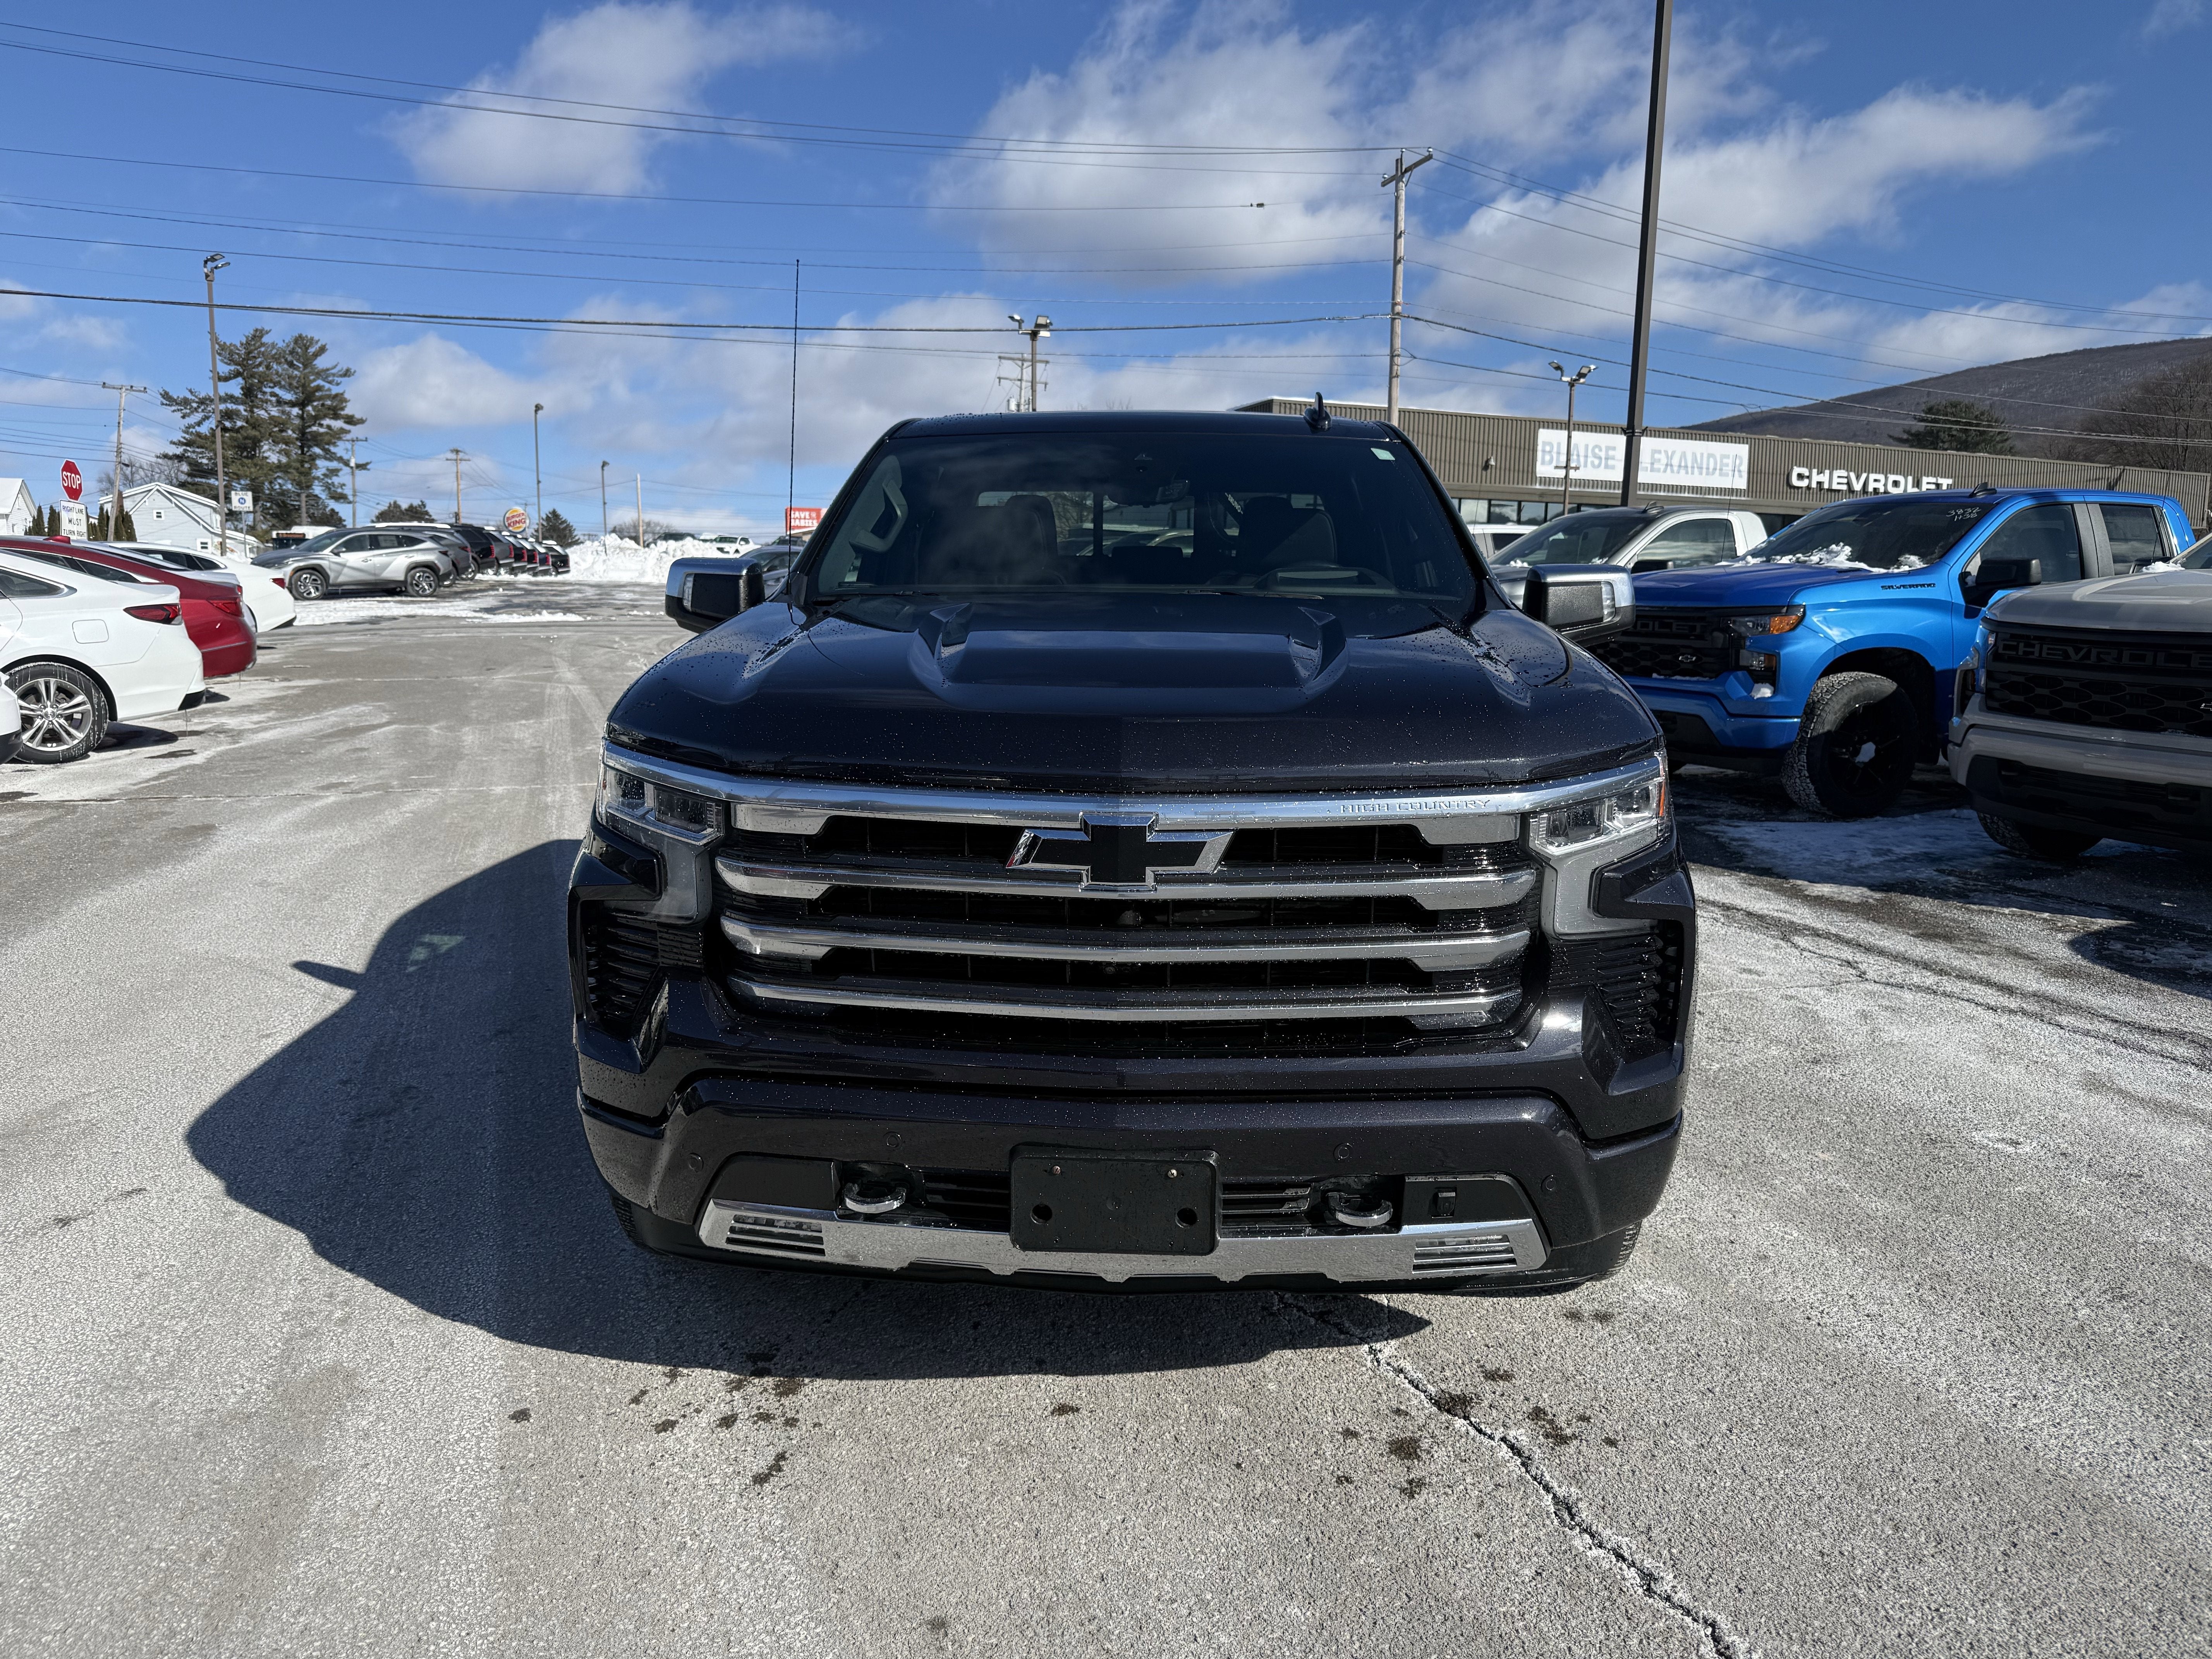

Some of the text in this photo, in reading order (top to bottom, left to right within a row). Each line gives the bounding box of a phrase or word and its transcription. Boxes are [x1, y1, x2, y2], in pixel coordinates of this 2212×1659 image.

[1540, 441, 1743, 478] BLAISE LEXANDER
[63, 471, 81, 489] STOP
[1791, 466, 1953, 494] CHEVROLET
[68, 517, 81, 526] MUST
[506, 513, 524, 522] BURGER
[508, 519, 526, 528] KING
[1881, 582, 1936, 591] SILVERADO
[1998, 641, 2212, 668] CHEVROLE
[1340, 799, 1491, 813] HIGH COUNTRY
